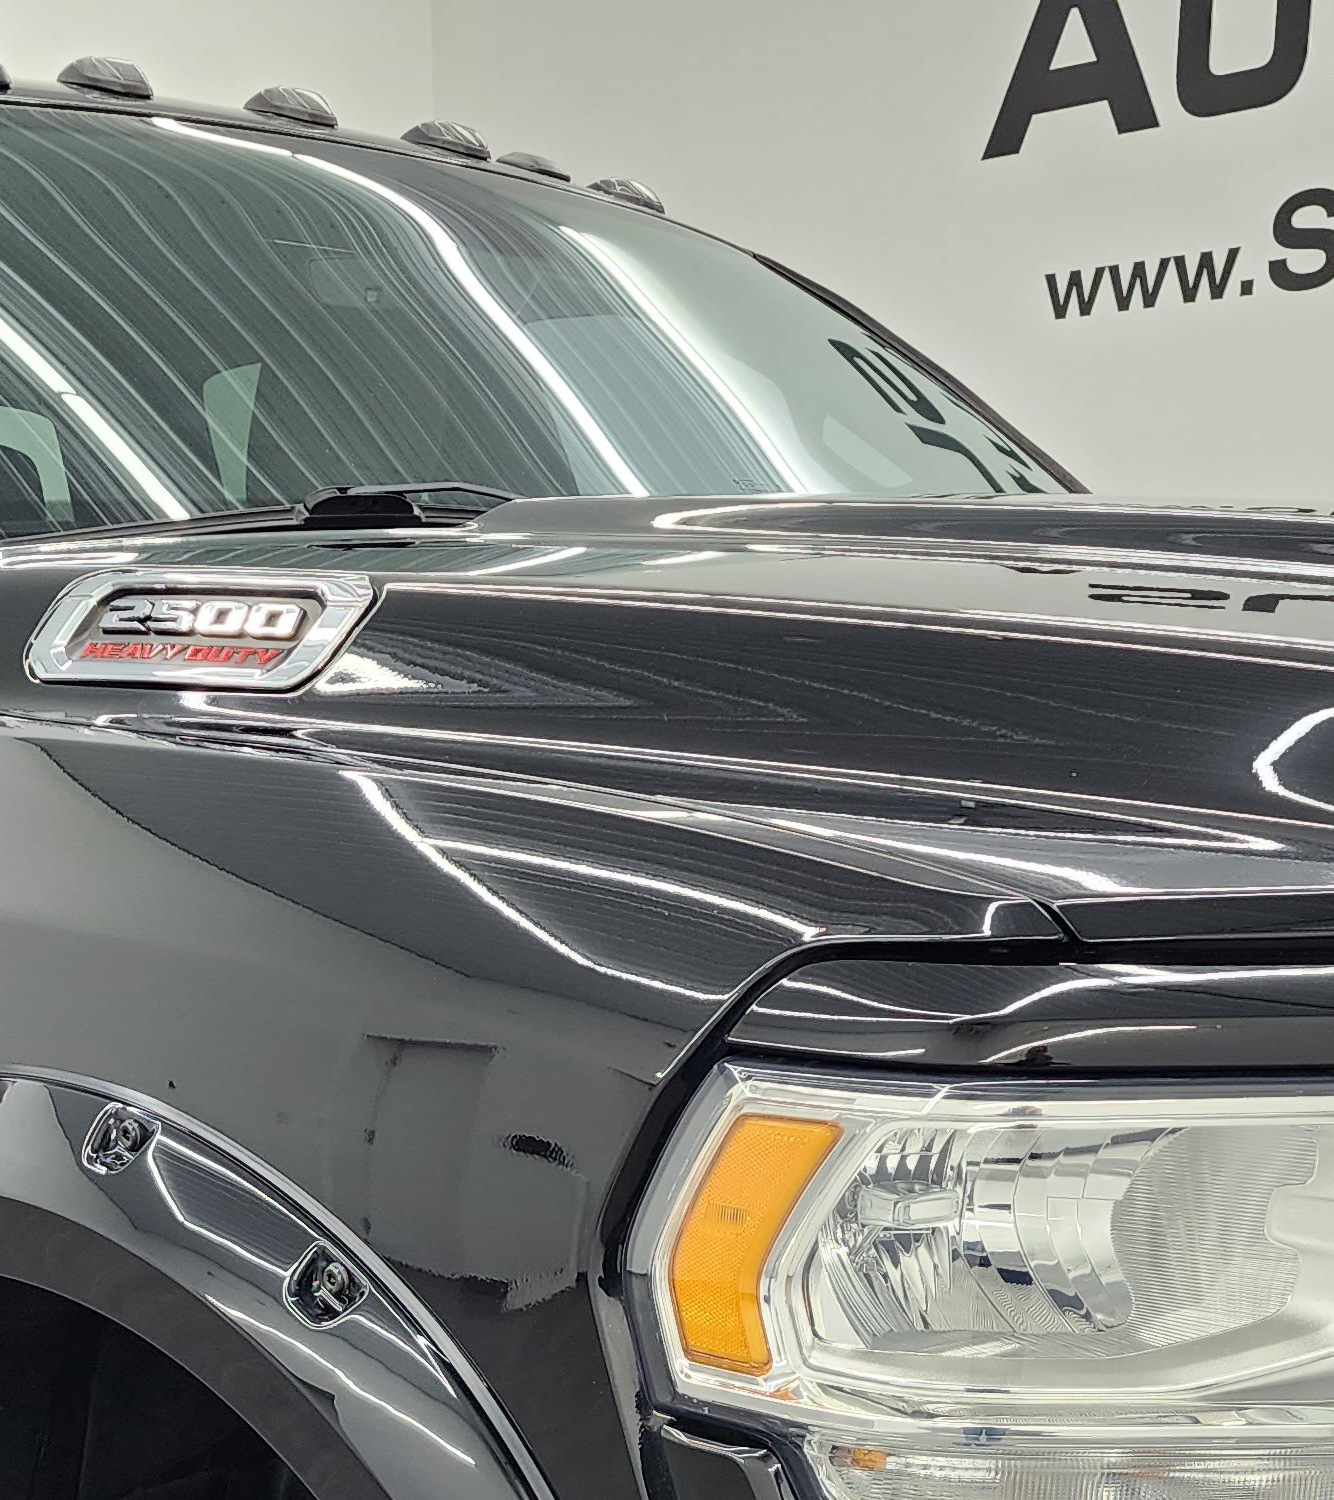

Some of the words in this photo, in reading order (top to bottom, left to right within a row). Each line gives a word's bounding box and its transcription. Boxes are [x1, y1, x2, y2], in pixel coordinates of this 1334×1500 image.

[98, 598, 307, 641] 2500
[81, 641, 186, 662] HEAVY
[182, 645, 287, 666] DUTY
